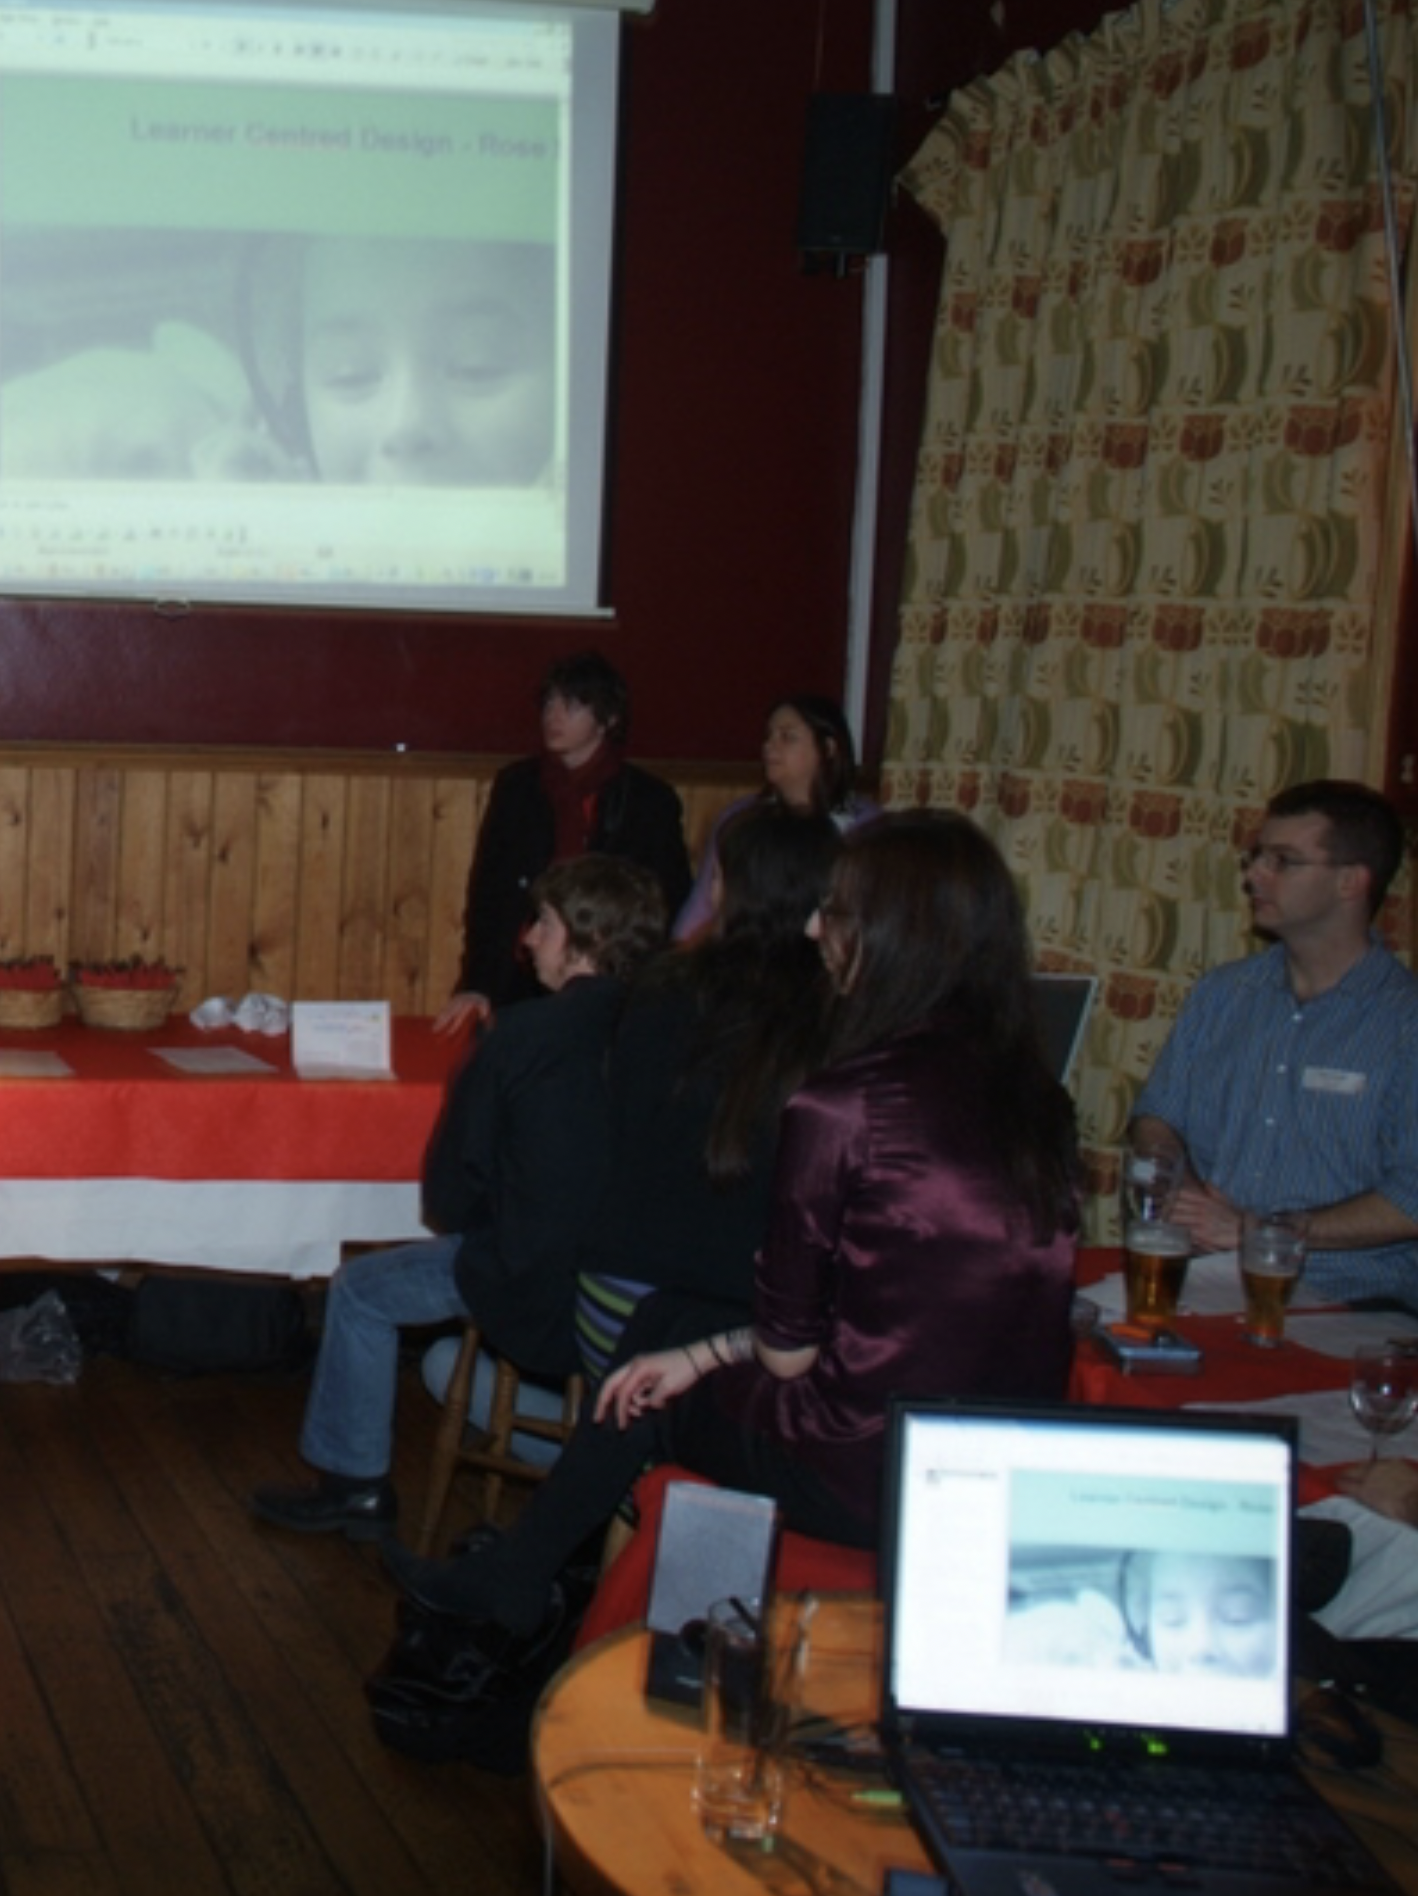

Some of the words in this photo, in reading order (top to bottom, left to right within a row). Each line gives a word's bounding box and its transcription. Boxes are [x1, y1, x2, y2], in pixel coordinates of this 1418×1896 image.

[130, 114, 237, 143] Learner
[244, 119, 351, 148] Centred
[360, 124, 453, 156] Design
[478, 131, 548, 157] Rose
